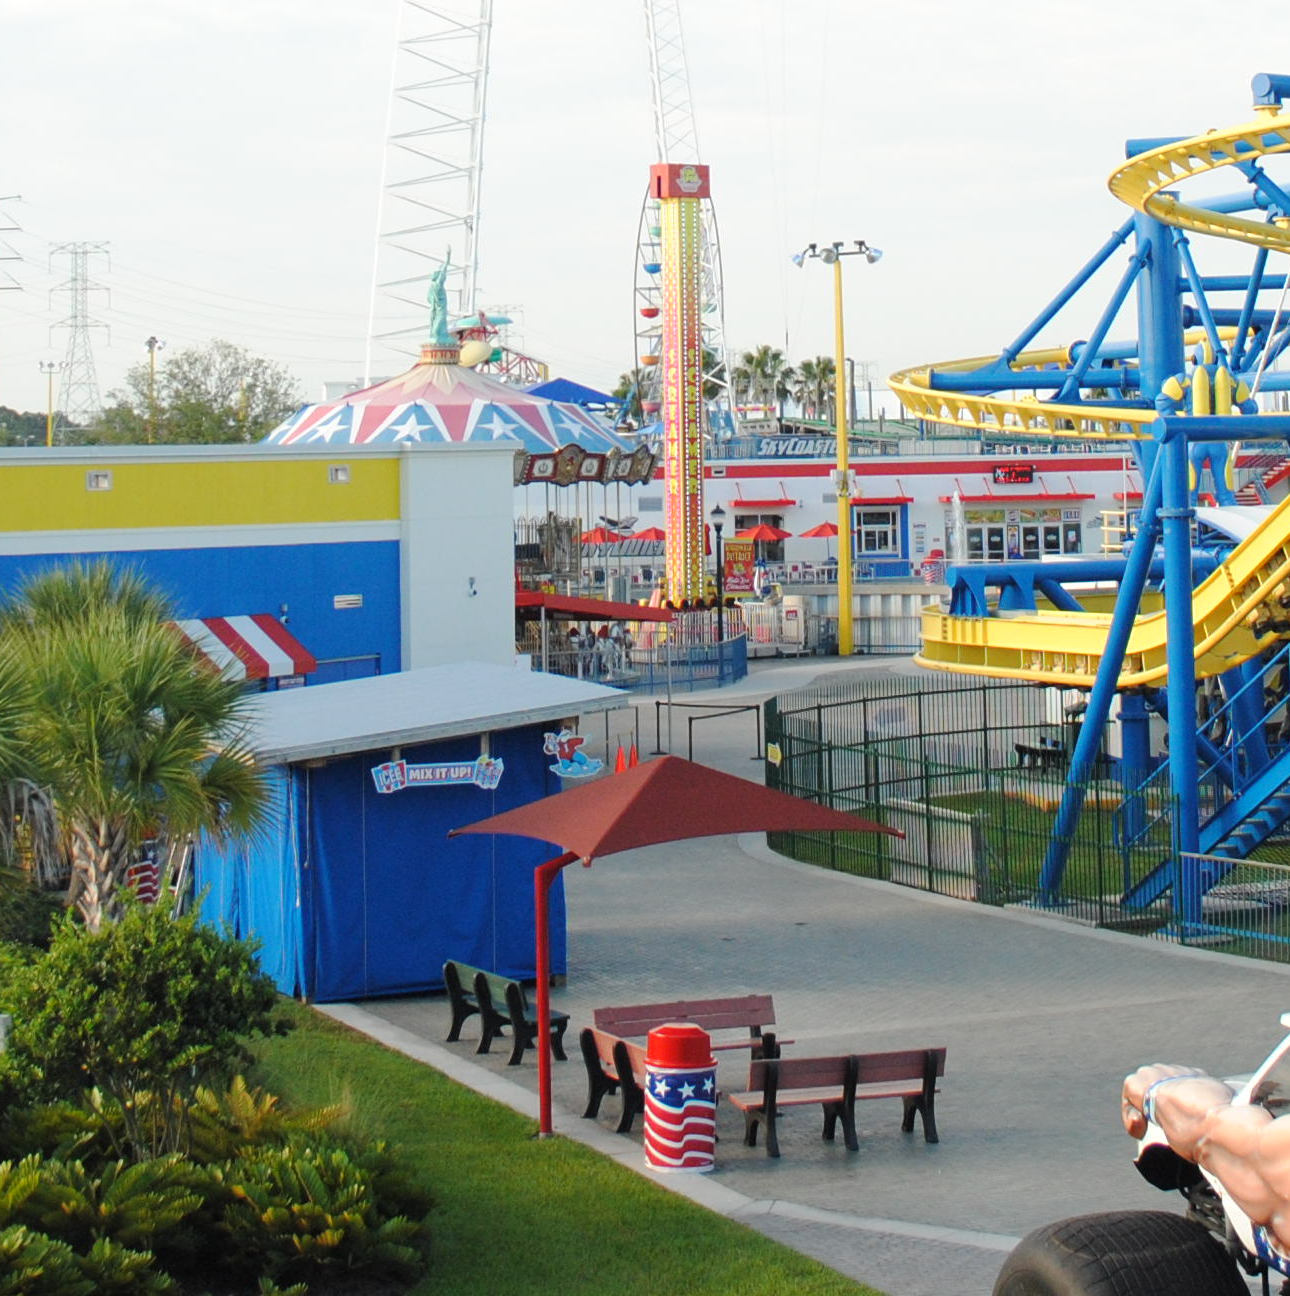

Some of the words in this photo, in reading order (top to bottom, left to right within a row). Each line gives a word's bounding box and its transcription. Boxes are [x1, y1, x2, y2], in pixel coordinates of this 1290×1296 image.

[687, 348, 698, 495] SCREAMER
[757, 437, 837, 455] SKYCOASTE
[378, 766, 404, 786] ICEE
[409, 768, 433, 781] MIX
[435, 767, 448, 779] IT
[451, 766, 472, 779] UP!
